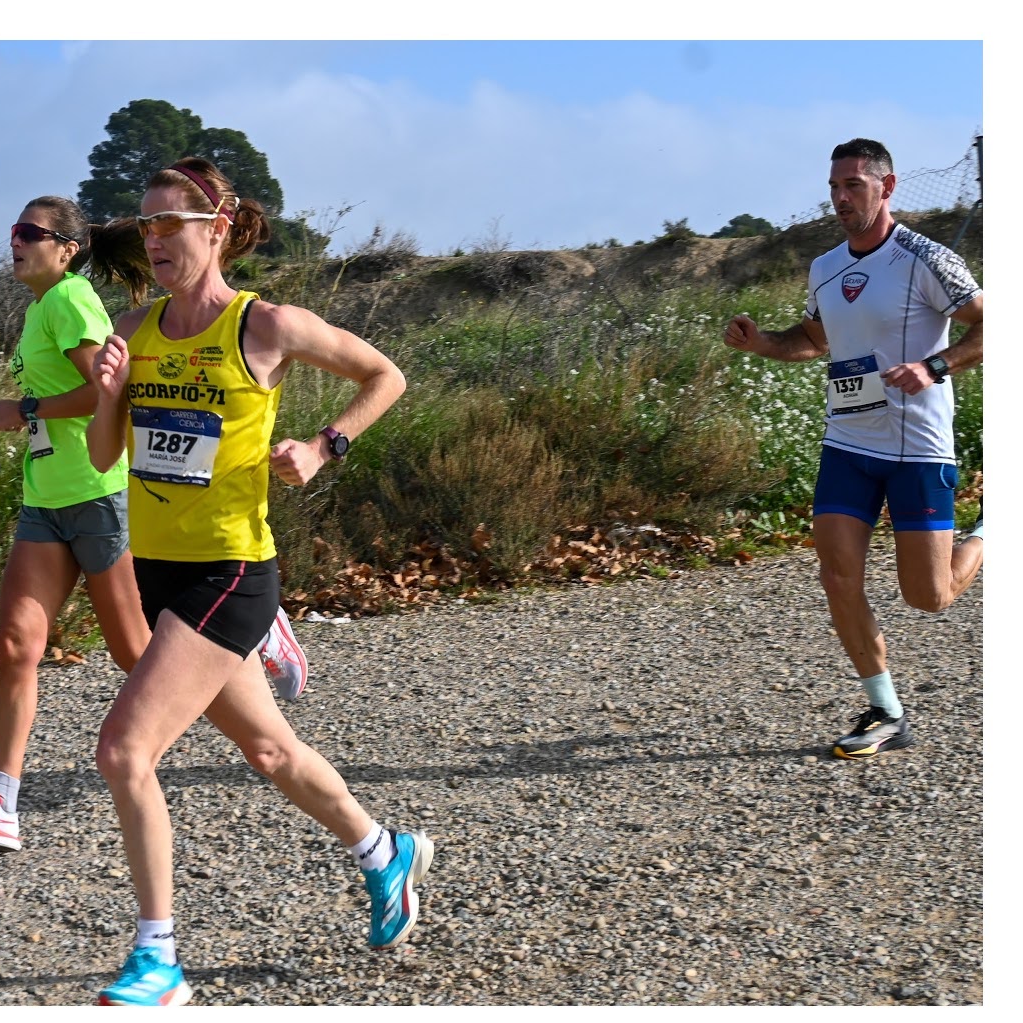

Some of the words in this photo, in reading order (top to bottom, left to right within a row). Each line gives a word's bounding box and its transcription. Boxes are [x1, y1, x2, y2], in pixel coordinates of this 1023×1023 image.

[833, 376, 863, 393] 1337
[129, 383, 225, 405] SCORPIO-71
[170, 410, 197, 419] CARRERA
[179, 419, 205, 429] CIENCIA
[147, 430, 198, 455] 1287
[149, 452, 168, 461] MARÍA
[169, 454, 187, 463] JOSÉ
